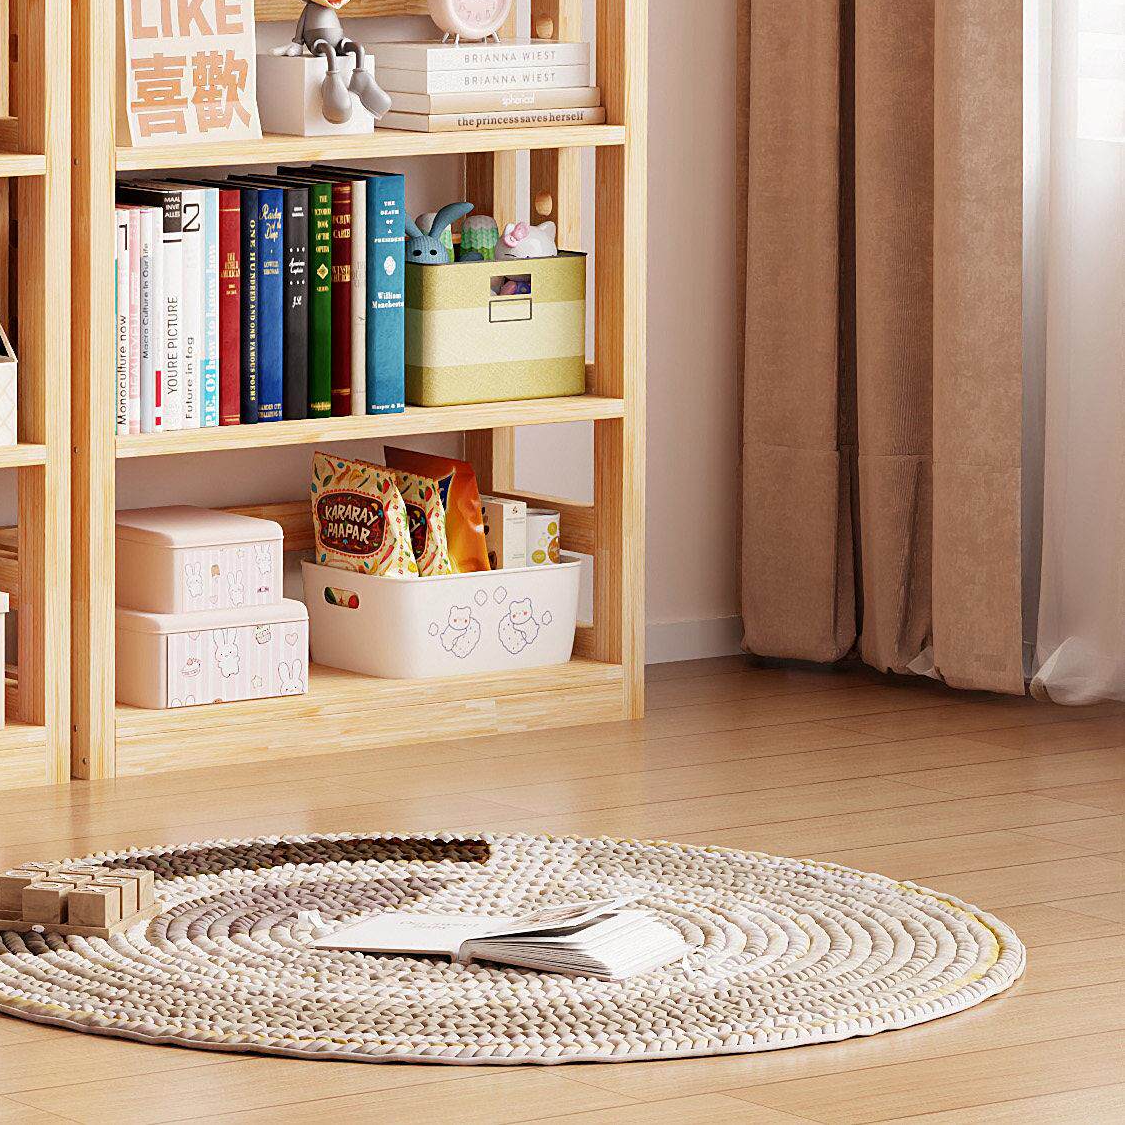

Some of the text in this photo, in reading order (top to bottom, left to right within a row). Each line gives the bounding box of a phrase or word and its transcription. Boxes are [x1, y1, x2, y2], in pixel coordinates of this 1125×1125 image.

[464, 50, 556, 64] BRIANNA WIEST
[464, 72, 556, 86] BRIANNA WIEST
[130, 49, 252, 138] 喜歡
[457, 111, 584, 128] the princess saves herself
[182, 203, 201, 233] 2
[118, 224, 128, 251] 1
[378, 291, 402, 300] William
[167, 296, 178, 395] YOURE PICTURE
[117, 315, 127, 425] Monoculture now
[185, 337, 195, 419] Future in fog
[324, 504, 379, 527] KARARAY
[327, 522, 371, 545] PAAPAR
